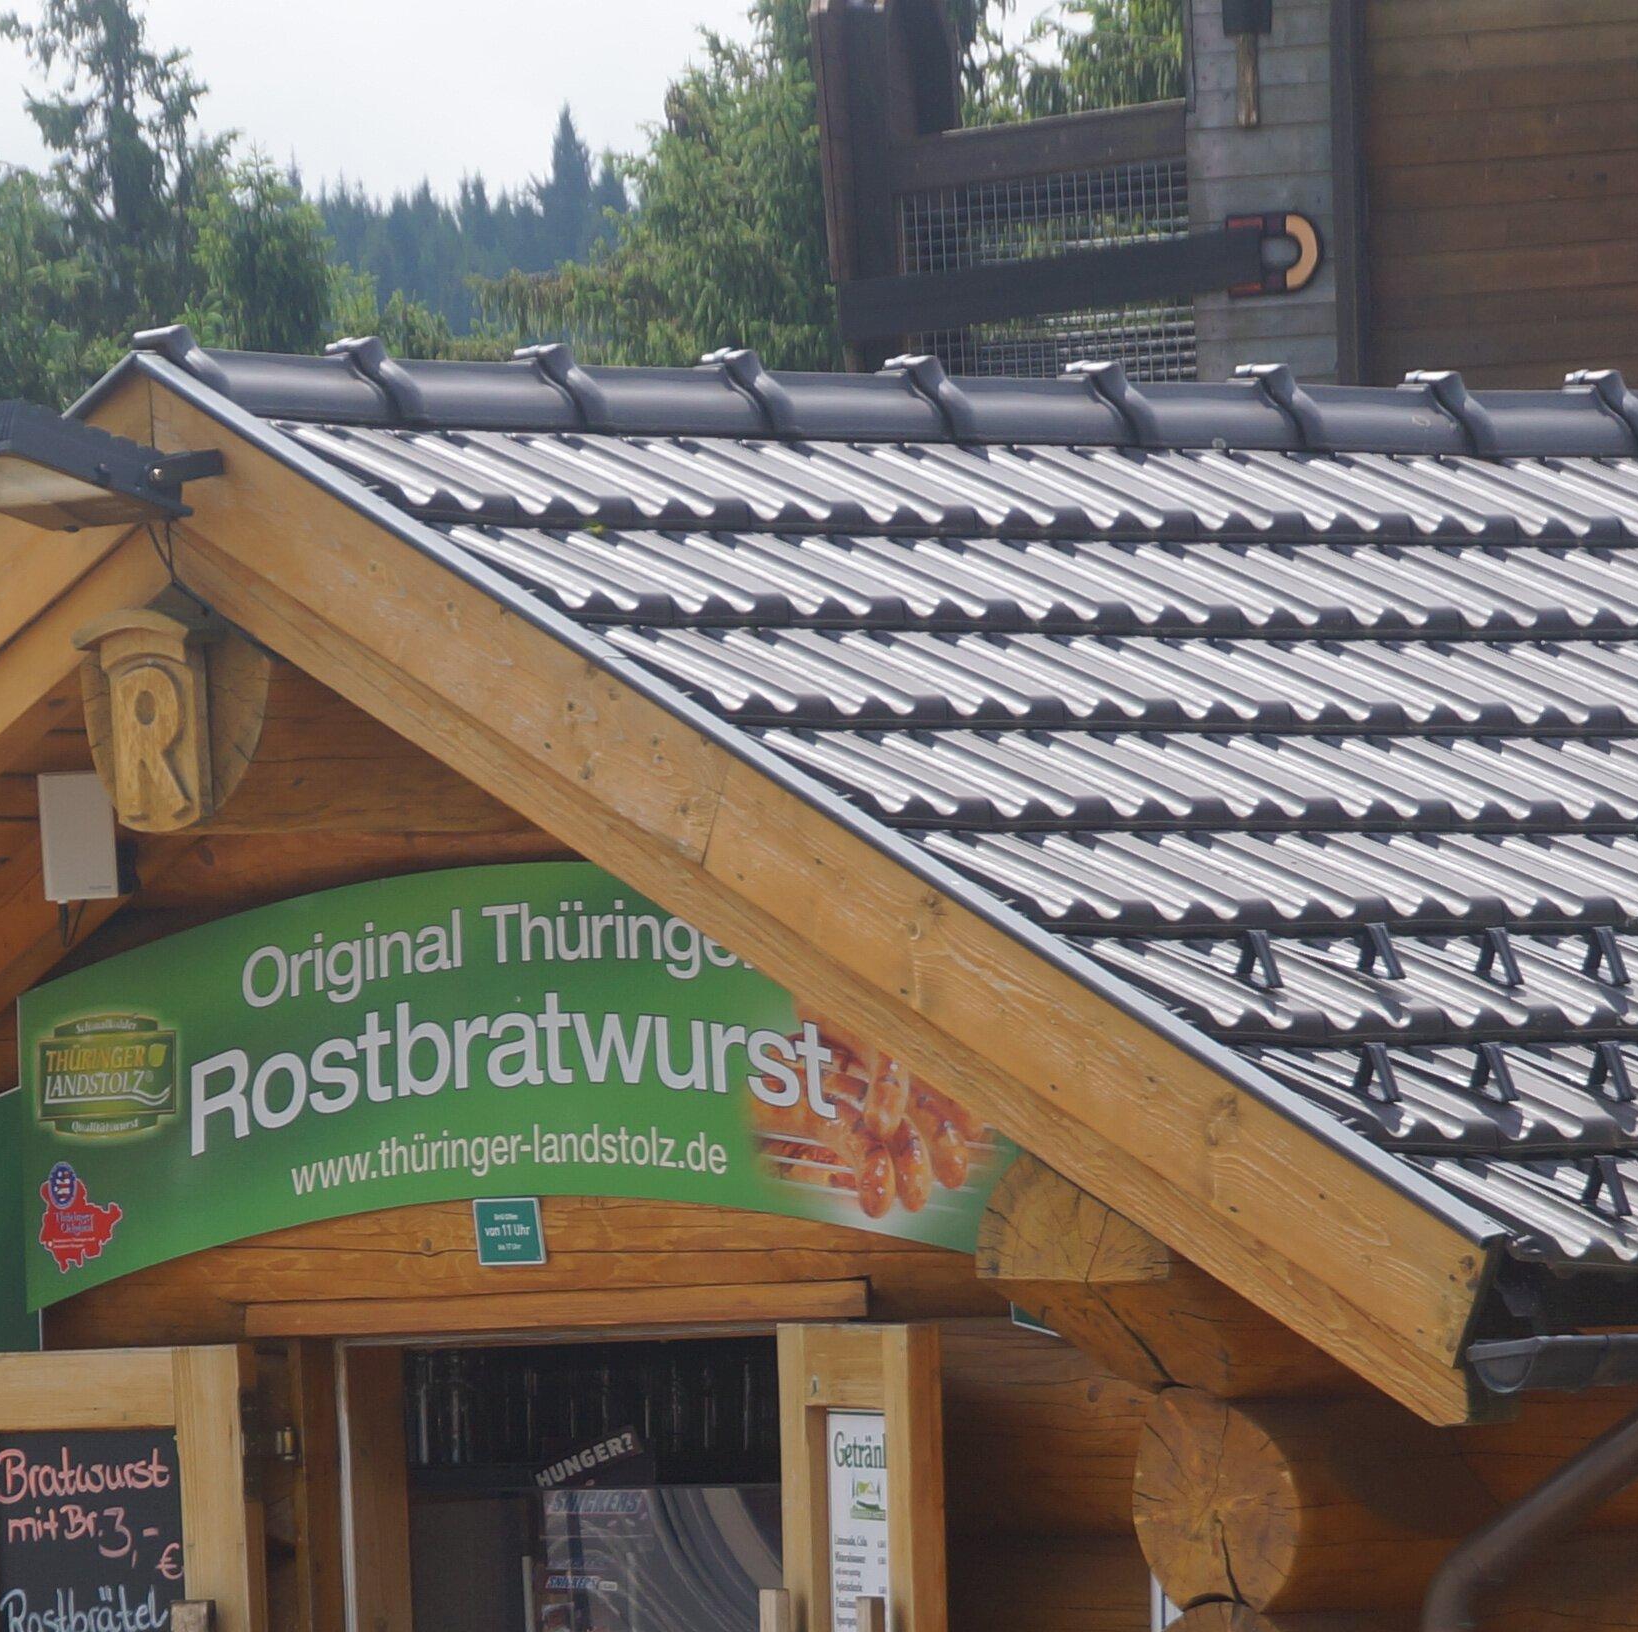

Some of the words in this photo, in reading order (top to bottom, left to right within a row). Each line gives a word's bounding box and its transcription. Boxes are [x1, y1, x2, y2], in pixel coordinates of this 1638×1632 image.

[240, 908, 464, 1009] Original
[480, 898, 754, 980] Thüringe
[46, 1045, 146, 1073] THÜRINGER
[189, 992, 838, 1157] Rostbratwurst
[44, 1069, 145, 1104] LANDSTOLZ
[289, 1122, 729, 1197] www.thüringer-landstolz.de
[513, 1223, 531, 1236] Uhr
[534, 1432, 634, 1488] HUNGER?
[8, 1506, 59, 1544] mit
